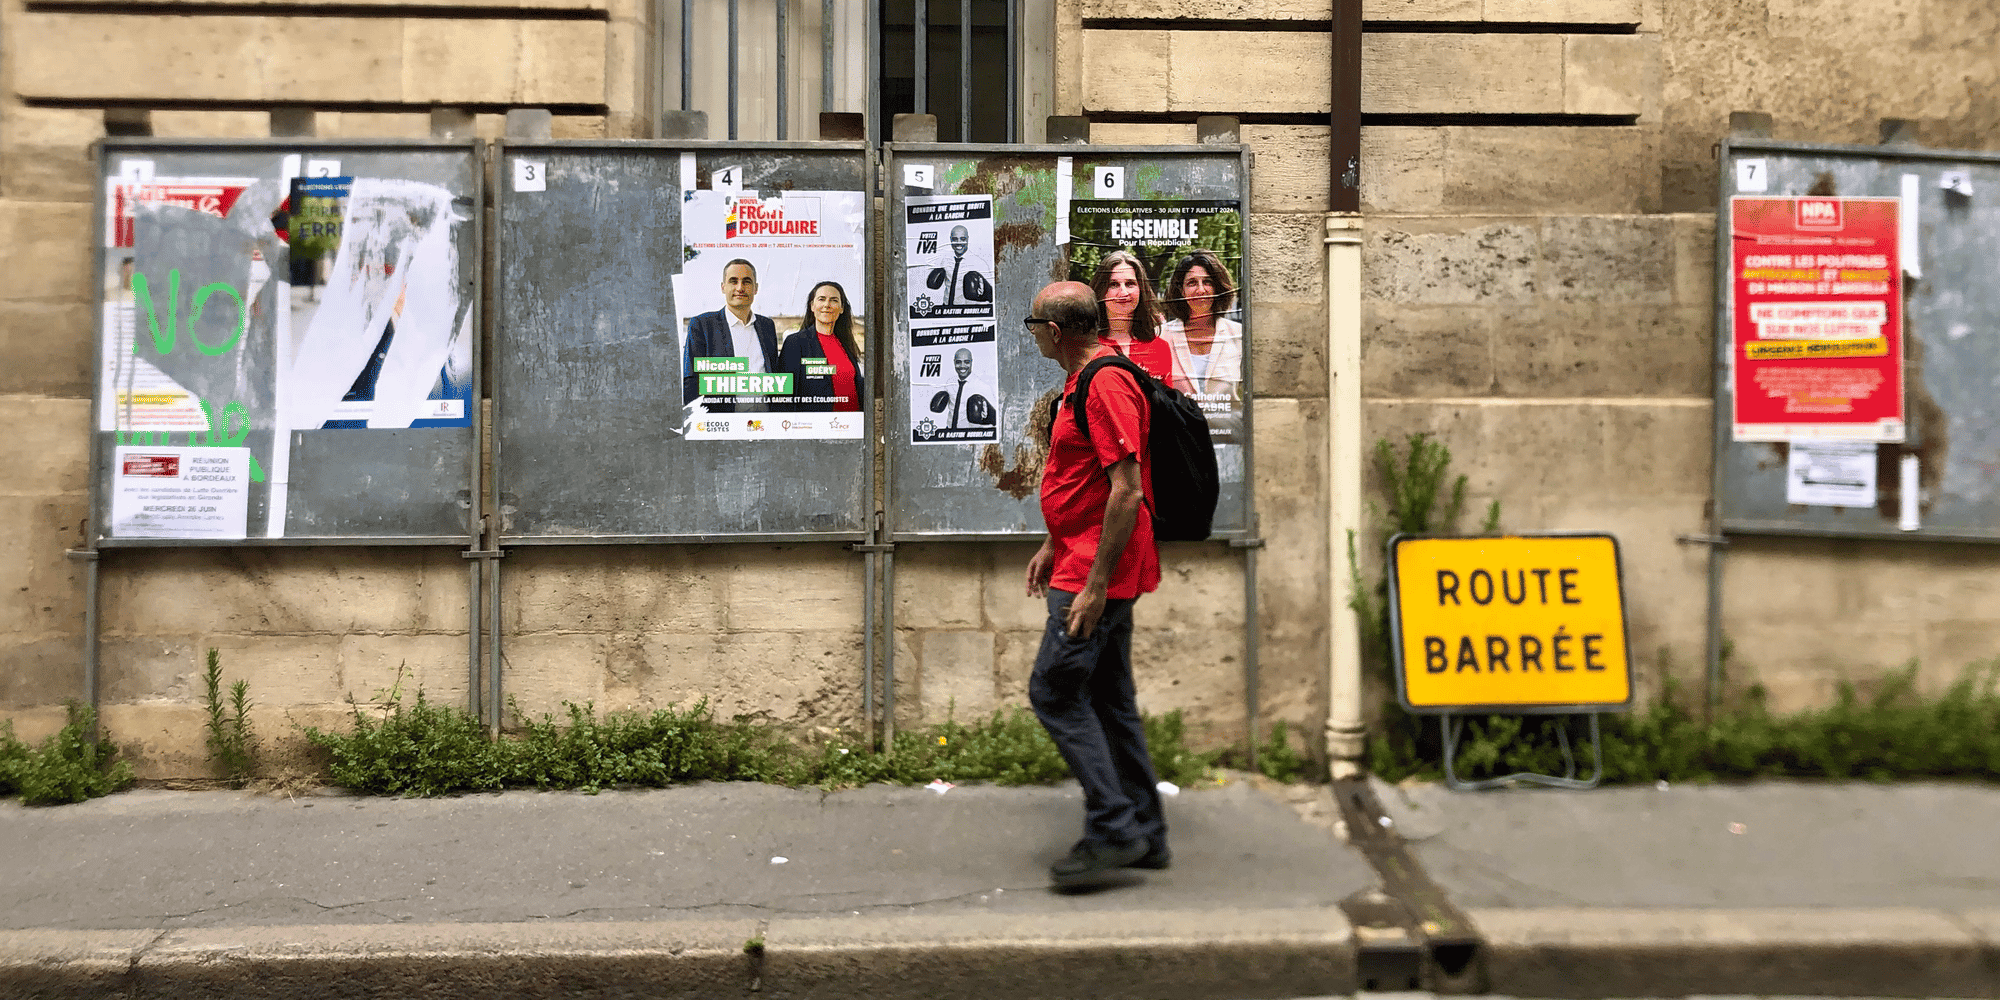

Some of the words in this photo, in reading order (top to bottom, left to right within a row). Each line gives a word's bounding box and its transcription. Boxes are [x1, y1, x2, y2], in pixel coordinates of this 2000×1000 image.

[525, 165, 536, 181] 3
[721, 170, 733, 186] 4
[914, 171, 925, 183] 5
[1746, 164, 1758, 180] 7
[1104, 172, 1115, 188] 6
[944, 212, 965, 220] GAUCHE
[1077, 206, 1111, 214] ÉLECTIONS
[1111, 206, 1153, 214] LÉGISLATIVES
[1802, 202, 1836, 217] NPA
[739, 220, 818, 235] POPULAIRE
[1111, 218, 1199, 239] ENSEMBLE
[916, 240, 938, 254] IVA
[1147, 238, 1192, 248] République
[131, 267, 246, 357] NO
[935, 307, 943, 315] LA
[696, 360, 745, 371] Nicolas
[807, 365, 834, 375] GUÉRY
[919, 363, 941, 377] IVA
[703, 376, 788, 393] THIERRY
[1184, 392, 1232, 401] Catherine
[1198, 402, 1232, 412] FABRE
[1436, 568, 1582, 607] ROUTE
[1424, 625, 1607, 675] BARRÉE
